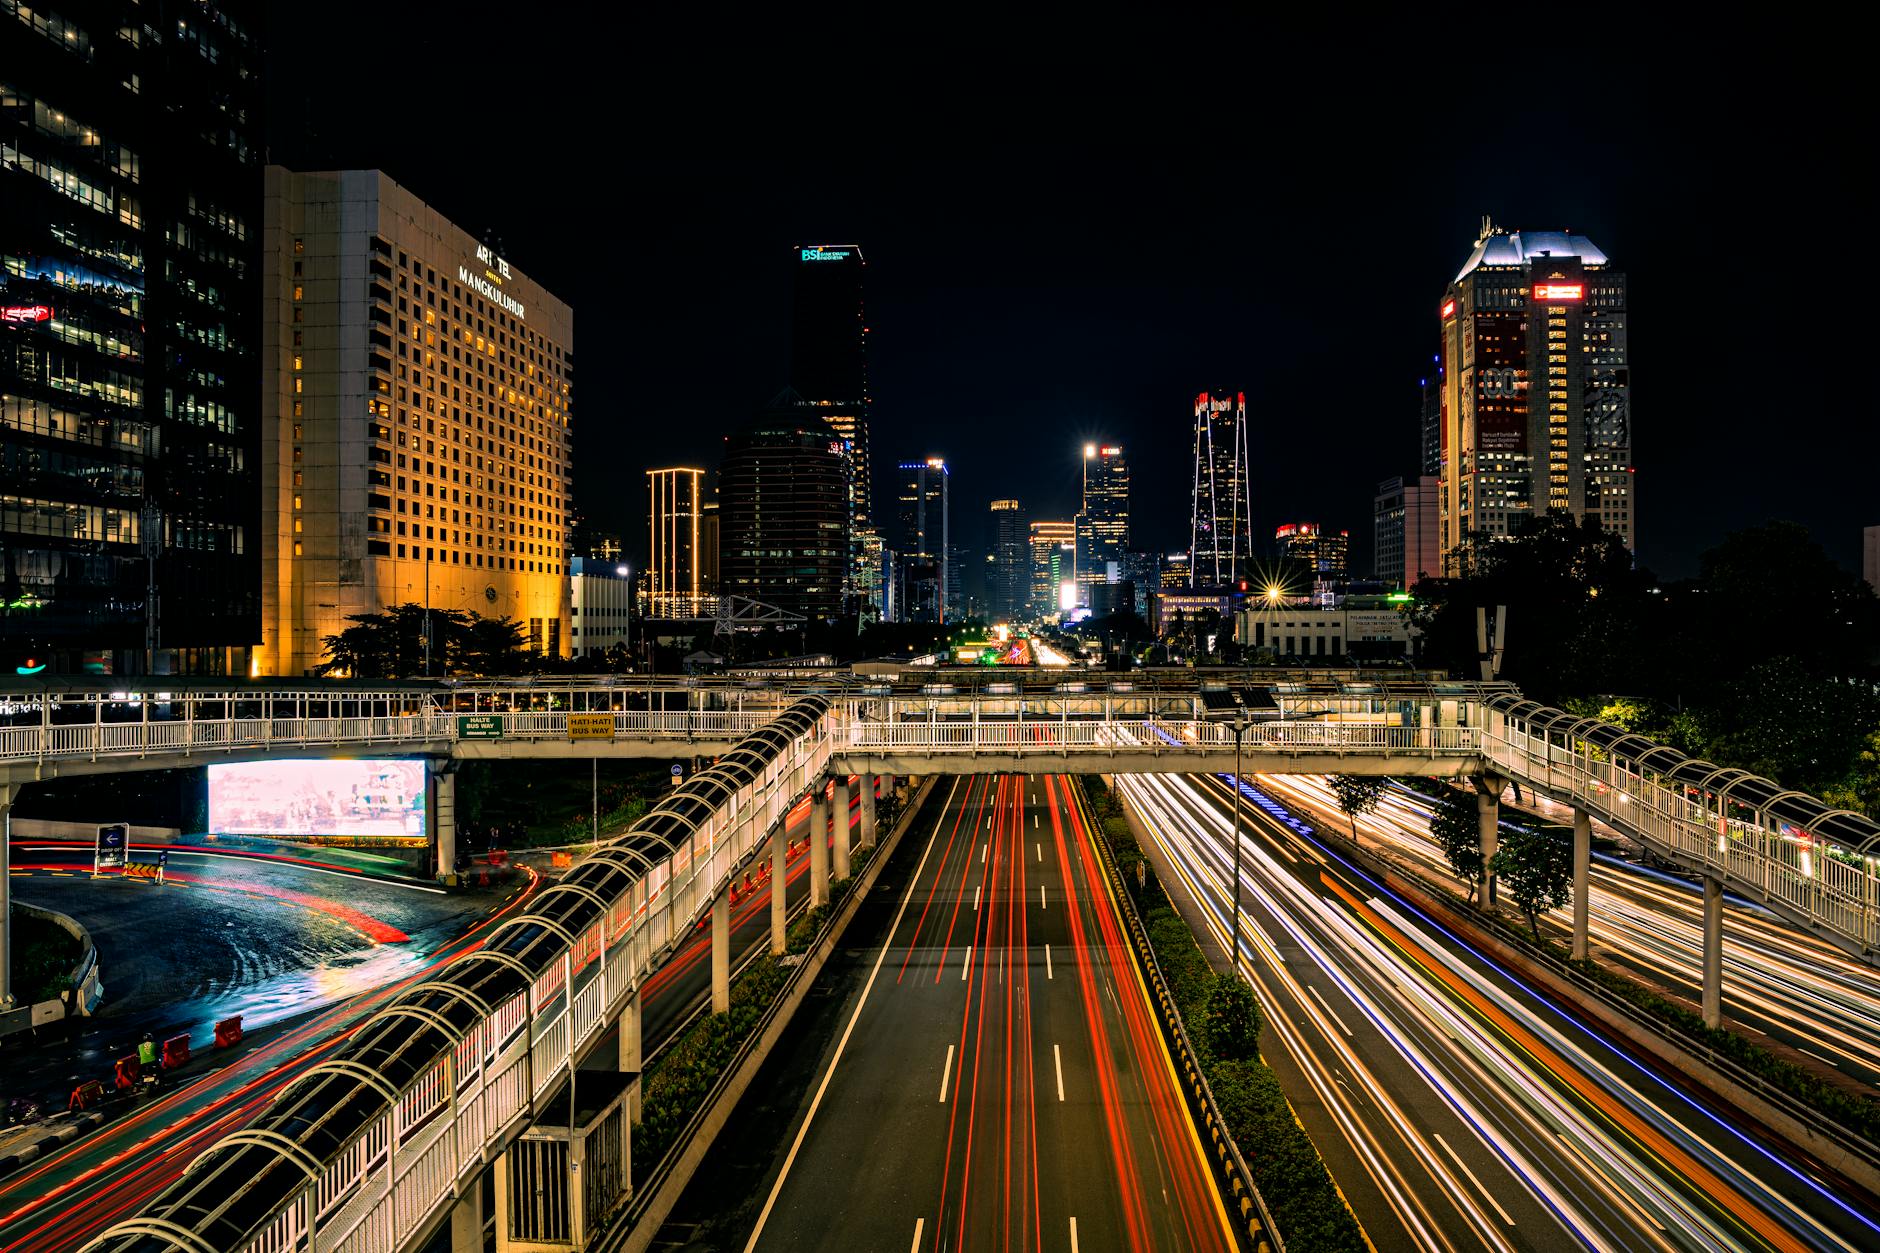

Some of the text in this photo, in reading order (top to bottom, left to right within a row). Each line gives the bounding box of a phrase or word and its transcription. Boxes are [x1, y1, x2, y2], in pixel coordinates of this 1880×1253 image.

[802, 249, 821, 261] BSI
[485, 269, 502, 285] SUITES
[459, 265, 525, 320] MANGKULUHUR
[570, 718, 611, 726] HATI-HATI
[572, 727, 610, 735] BUS WAY
